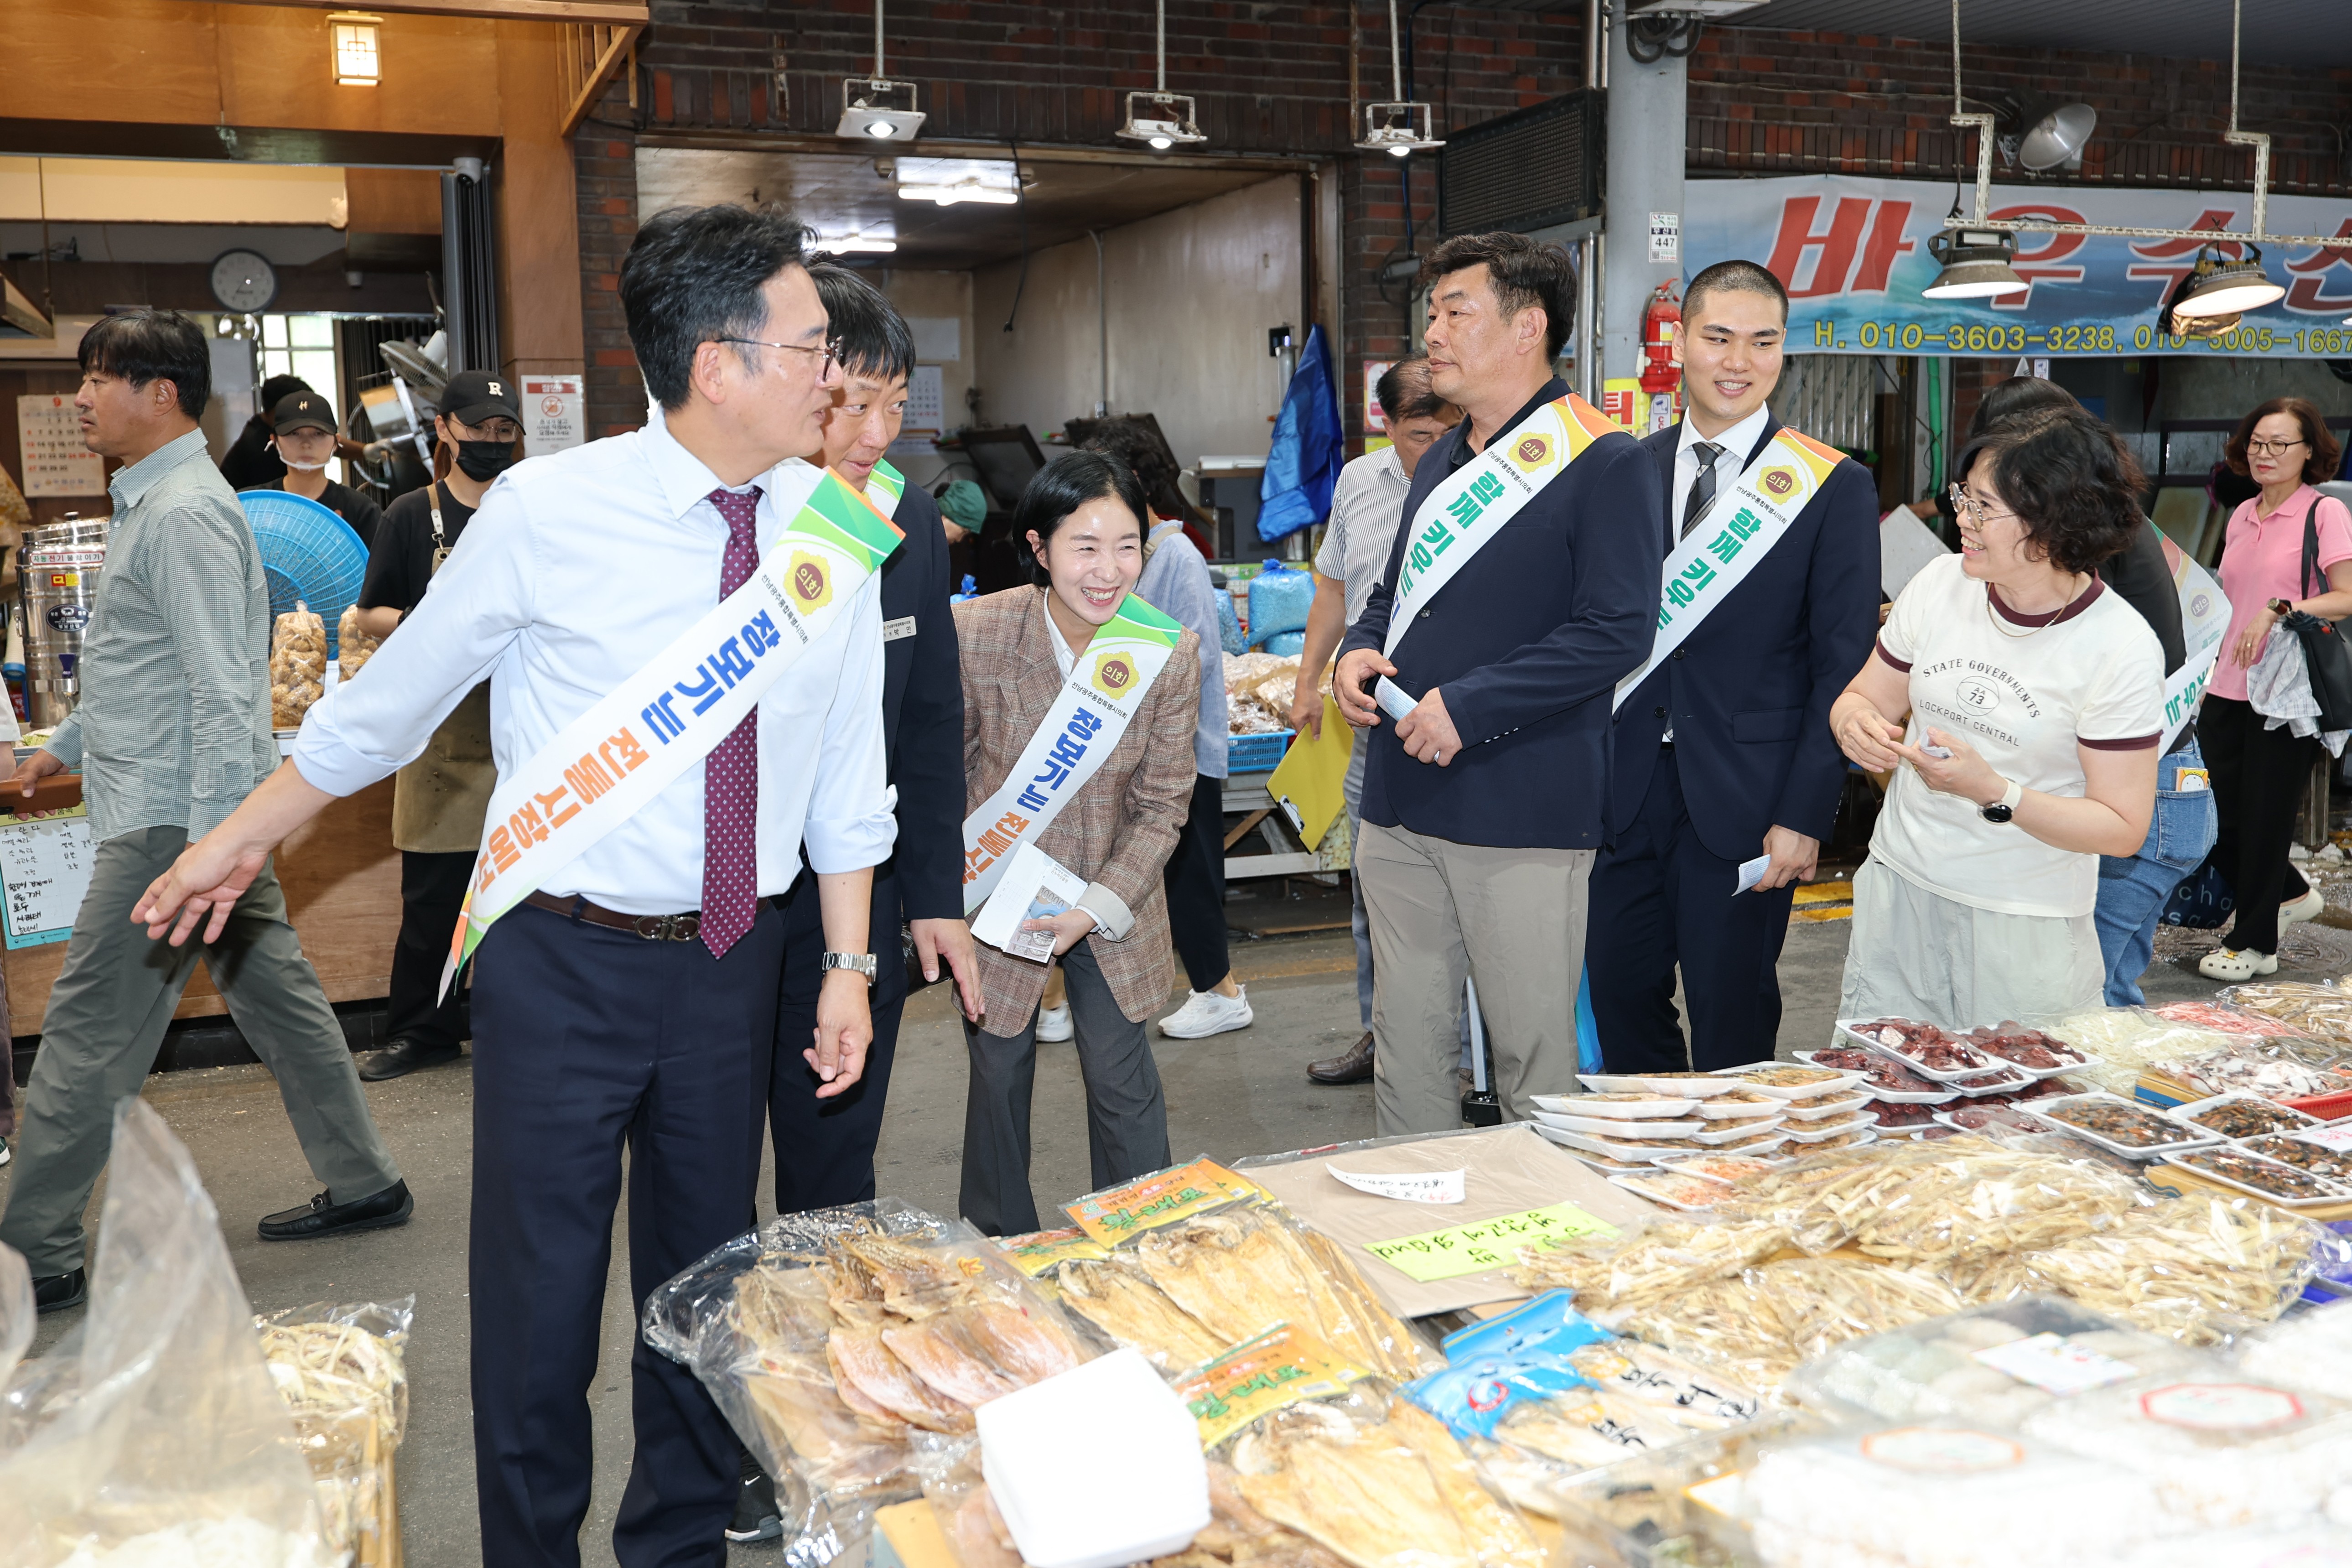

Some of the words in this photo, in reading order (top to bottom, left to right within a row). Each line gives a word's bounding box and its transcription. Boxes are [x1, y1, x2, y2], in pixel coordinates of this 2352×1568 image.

[1655, 238, 1675, 247] 447
[488, 382, 503, 396] R
[1521, 441, 1544, 461] 의회
[1488, 450, 1533, 494] 전남광주통합특별시의회
[1766, 474, 1791, 492] 의회
[1446, 470, 1506, 530] 함께
[1736, 485, 1787, 524] 전남광주통합특별시의회
[1706, 507, 1762, 565] 함께
[796, 567, 821, 598] 의회
[761, 574, 809, 645] 전남광주통합특별시의회
[641, 608, 781, 745] 장보기는
[1102, 666, 1127, 685] 의회
[1923, 658, 1963, 677] STATE
[1968, 660, 2041, 718] GOVERNMENTS
[1072, 681, 1128, 719] 전남광주통합특별시의회
[1969, 692, 1985, 705] 73
[1919, 699, 1968, 725] LOCKPORT
[1973, 722, 2020, 747] CENTRAL
[1017, 706, 1103, 813] 장보기는
[1039, 887, 1064, 909] 10000
